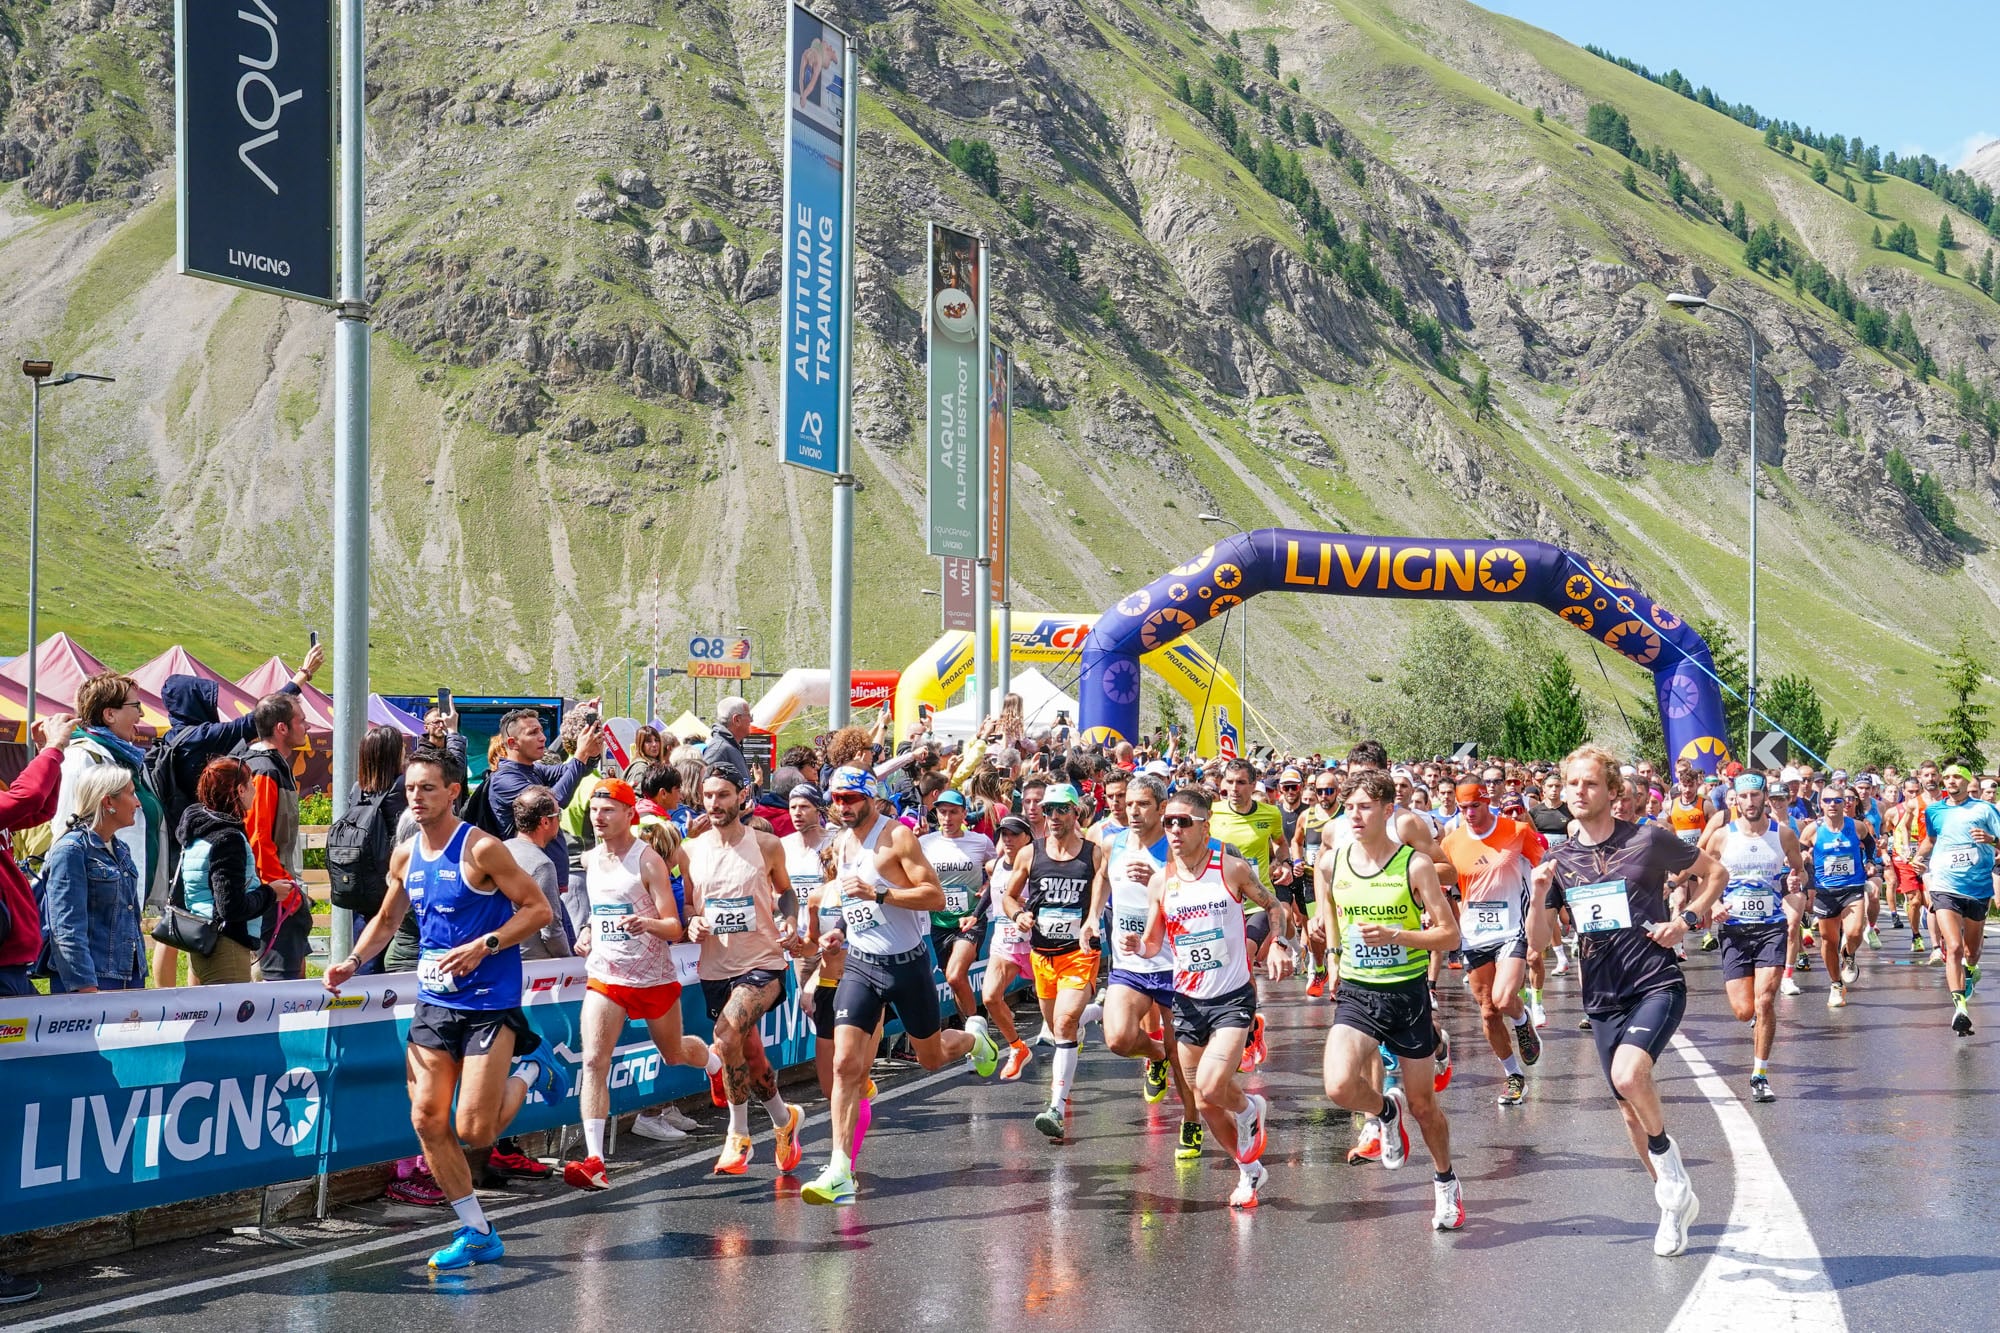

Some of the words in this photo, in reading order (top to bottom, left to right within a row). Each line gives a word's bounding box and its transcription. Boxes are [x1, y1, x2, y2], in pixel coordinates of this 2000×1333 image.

[229, 248, 291, 277] LIVIGNO
[795, 203, 812, 382] ALTITUDE
[816, 216, 833, 385] TRAINING
[958, 356, 969, 440] BISTROT
[941, 393, 954, 469] AQUA
[957, 443, 967, 511] ALPINE
[1285, 540, 1527, 594] LIVIGNO
[1011, 633, 1041, 643] PRO
[689, 637, 725, 659] Q8
[696, 662, 742, 678] 200mt
[1163, 650, 1209, 691] PROACTION.IT
[1952, 853, 1970, 863] 321
[1831, 863, 1849, 872] 756
[1040, 877, 1088, 892] SWATT
[796, 887, 815, 898] 13
[1045, 890, 1080, 904] CLUB
[1176, 904, 1207, 915] Silvano
[1208, 900, 1228, 909] Fedi
[1344, 904, 1408, 916] MERCURIO
[1591, 904, 1603, 921] 2
[1742, 900, 1765, 911] 180
[715, 912, 746, 926] 422
[847, 906, 873, 925] 693
[1479, 912, 1500, 923] 521
[1004, 927, 1017, 937] F2
[1120, 918, 1145, 933] 2165
[1585, 920, 1615, 931] LIVIGNO
[1190, 947, 1212, 963] 83
[1355, 943, 1401, 958] 2145B
[1191, 961, 1218, 971] LIVIGNO
[180, 1010, 209, 1021] INTRED
[20, 1066, 321, 1190] LIVIGNO
